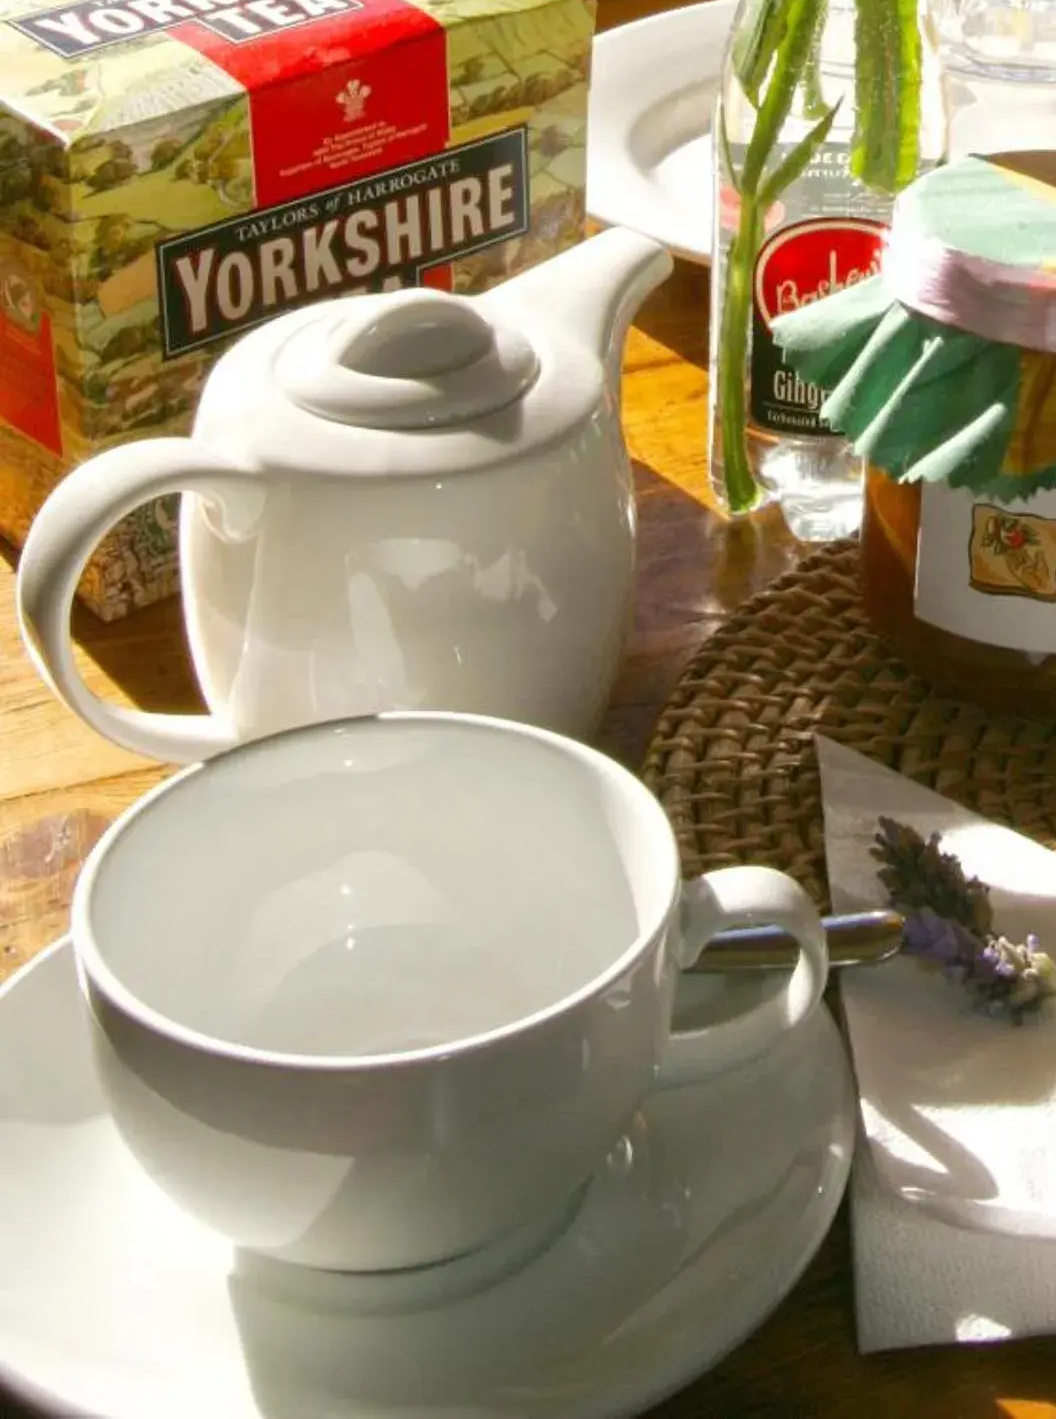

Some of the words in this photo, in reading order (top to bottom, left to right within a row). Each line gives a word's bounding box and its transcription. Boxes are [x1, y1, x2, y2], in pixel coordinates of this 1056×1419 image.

[175, 164, 516, 336] YORKSHIRE
[237, 202, 320, 241] TAYLORS
[325, 193, 342, 213] of
[348, 158, 461, 205] HARROGATE
